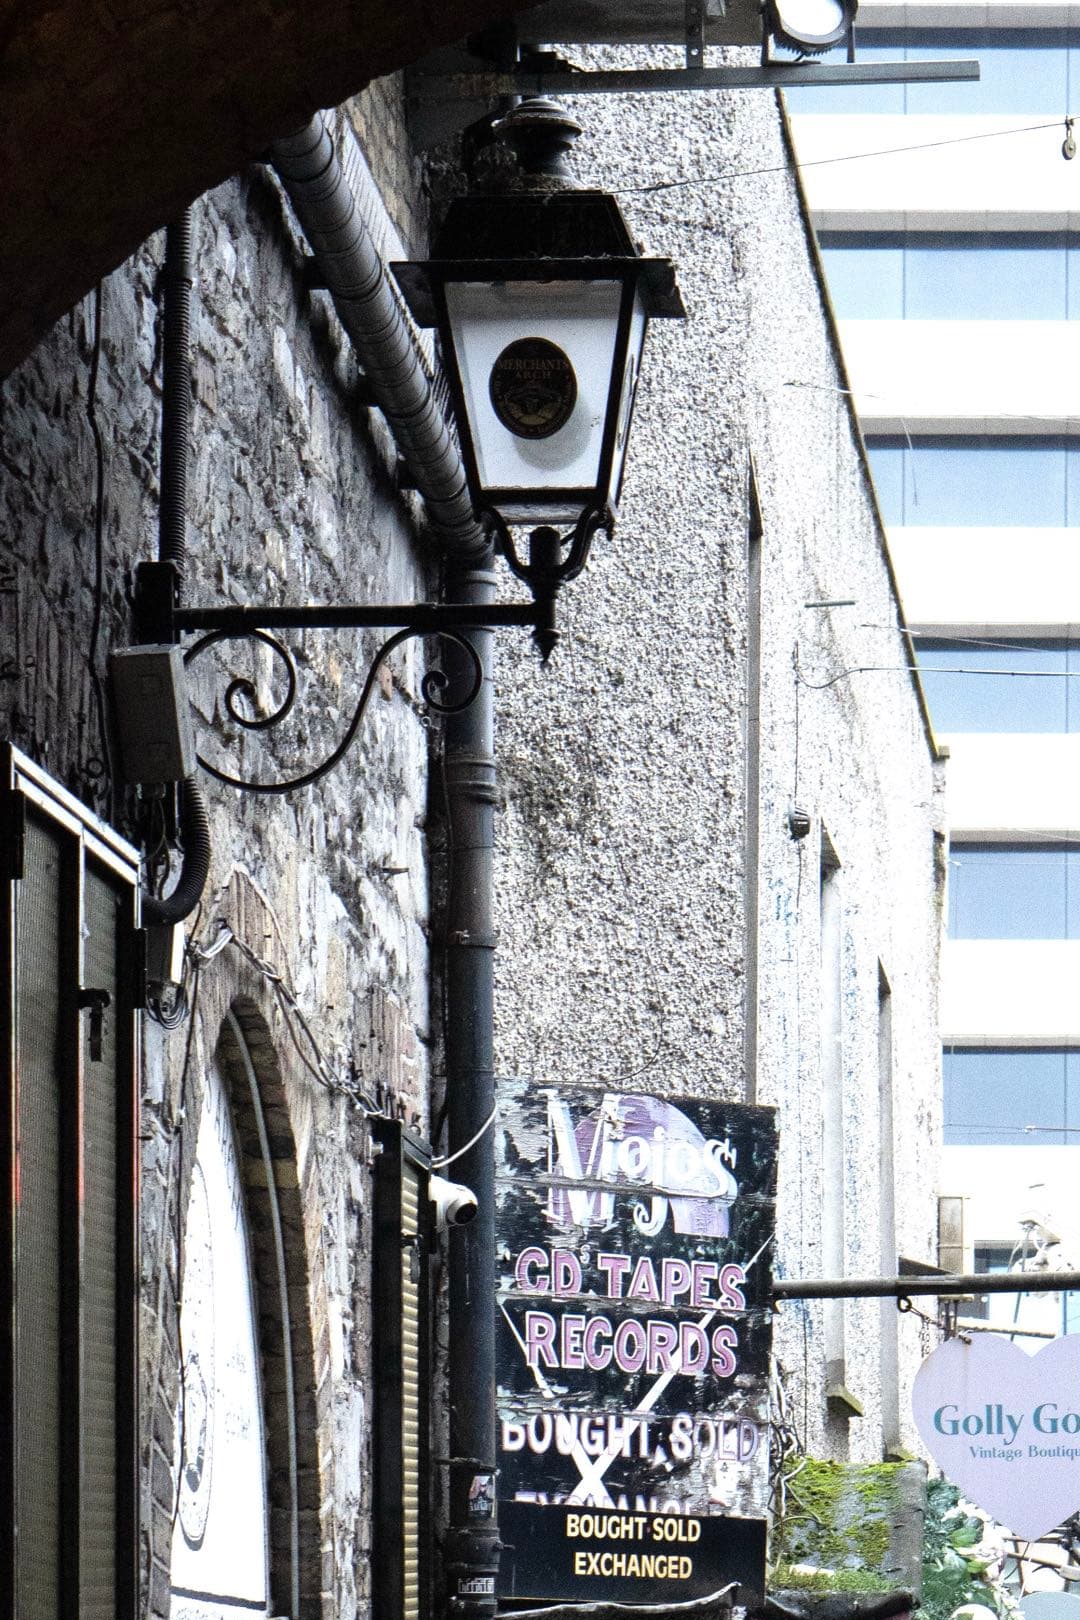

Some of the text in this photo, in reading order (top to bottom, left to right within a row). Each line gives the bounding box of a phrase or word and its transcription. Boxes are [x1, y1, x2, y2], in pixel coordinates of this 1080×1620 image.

[597, 1253, 746, 1311] TAPES
[525, 1311, 739, 1378] RECORDS
[933, 1404, 1025, 1446] Golly
[968, 1446, 1023, 1462] Vintage
[566, 1513, 702, 1542] BOUGHT SOLD
[574, 1551, 693, 1580] EXCHANGED
